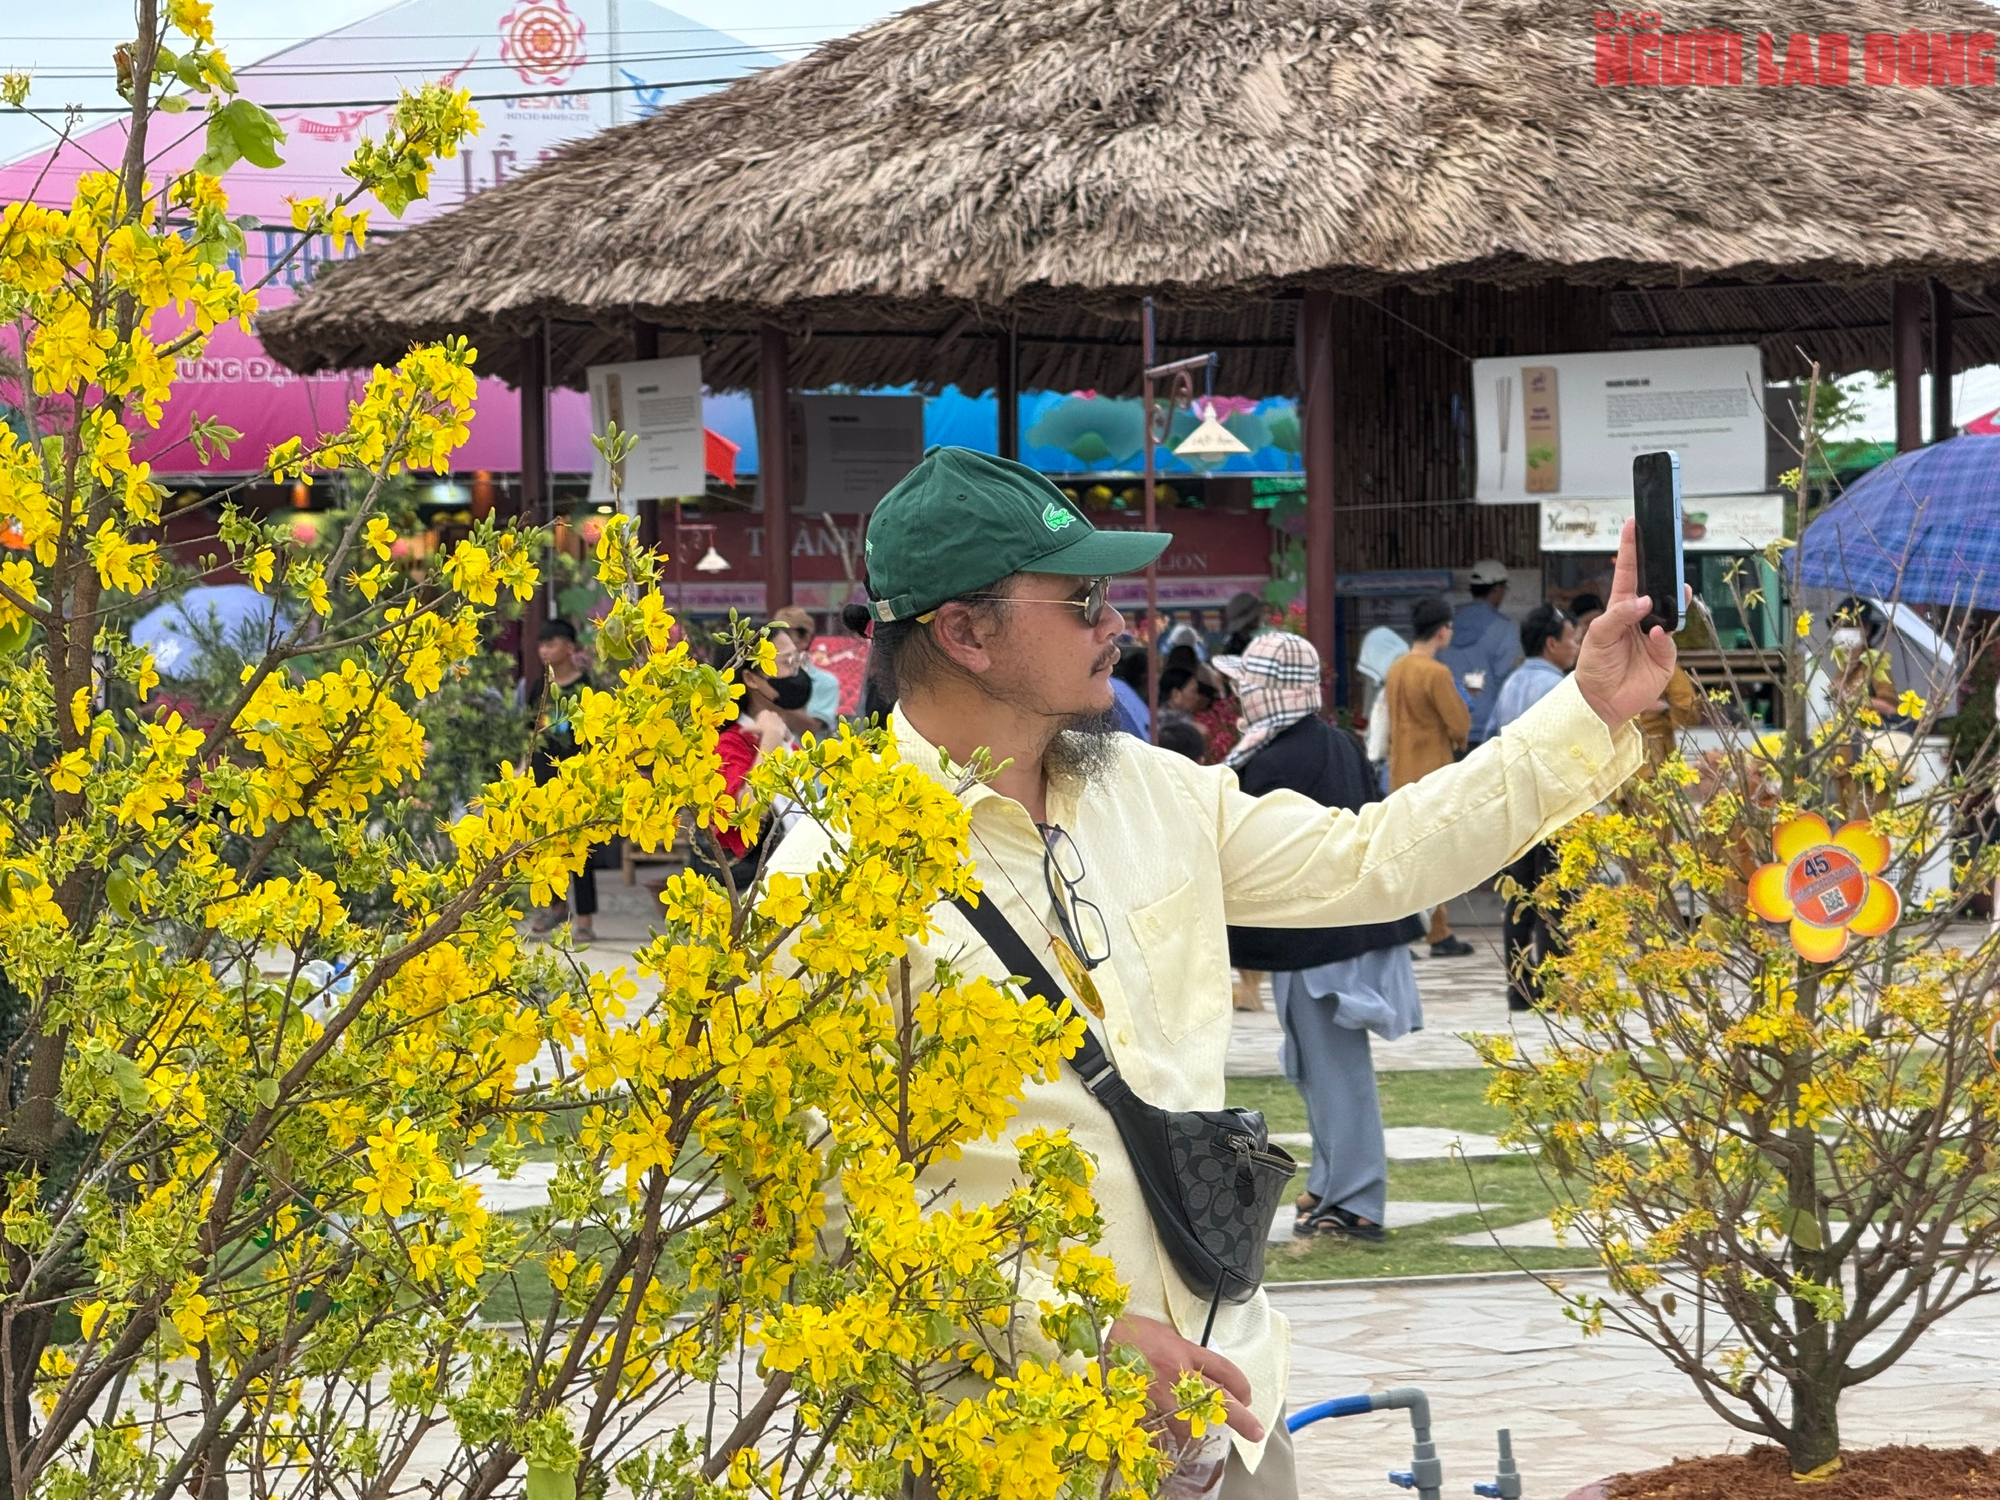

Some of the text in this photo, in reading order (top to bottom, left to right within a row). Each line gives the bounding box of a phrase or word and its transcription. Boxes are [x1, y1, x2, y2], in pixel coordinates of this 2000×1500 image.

[175, 357, 243, 382] UNG
[744, 521, 866, 558] TÀNH
[1804, 853, 1831, 877] 45
